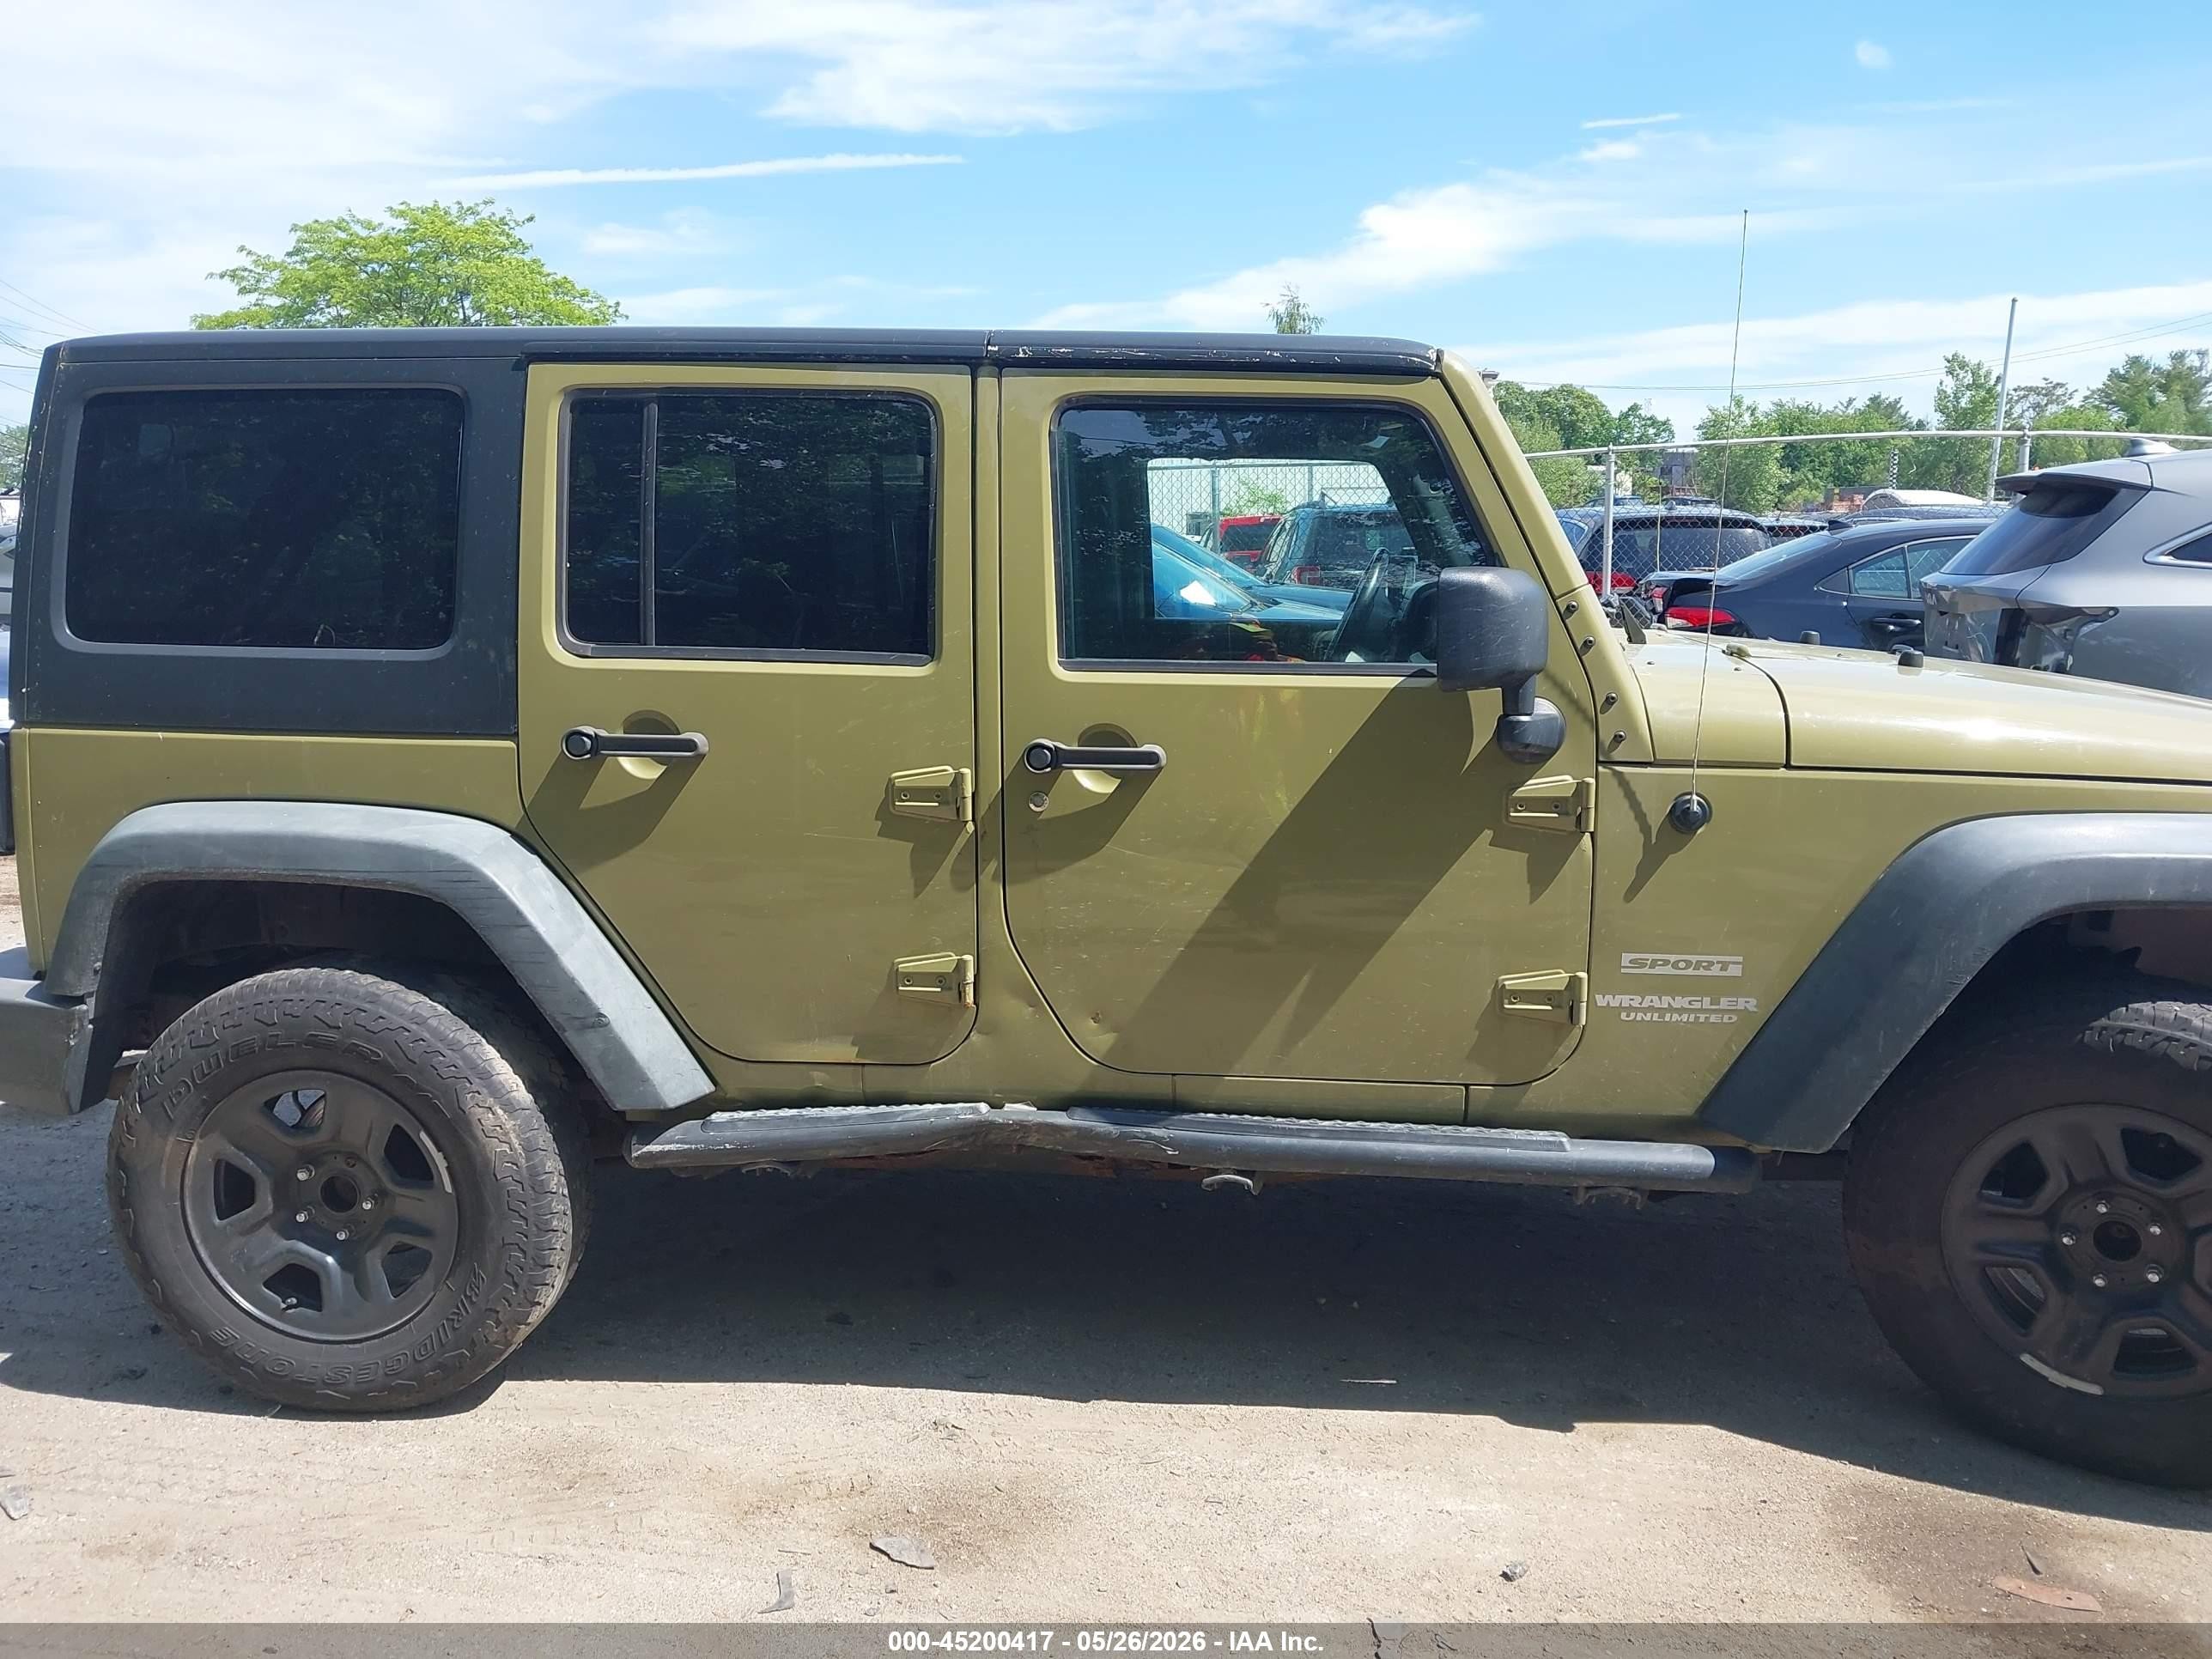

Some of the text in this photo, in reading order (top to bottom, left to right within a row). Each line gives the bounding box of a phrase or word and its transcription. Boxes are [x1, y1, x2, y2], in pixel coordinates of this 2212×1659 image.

[1626, 956, 1736, 973] SPORT
[1595, 994, 1759, 1012] WRANGLER
[1620, 1012, 1738, 1024] UNLIMITED
[162, 1030, 384, 1119] DUELER
[211, 1262, 487, 1384] BRIDGESTONE
